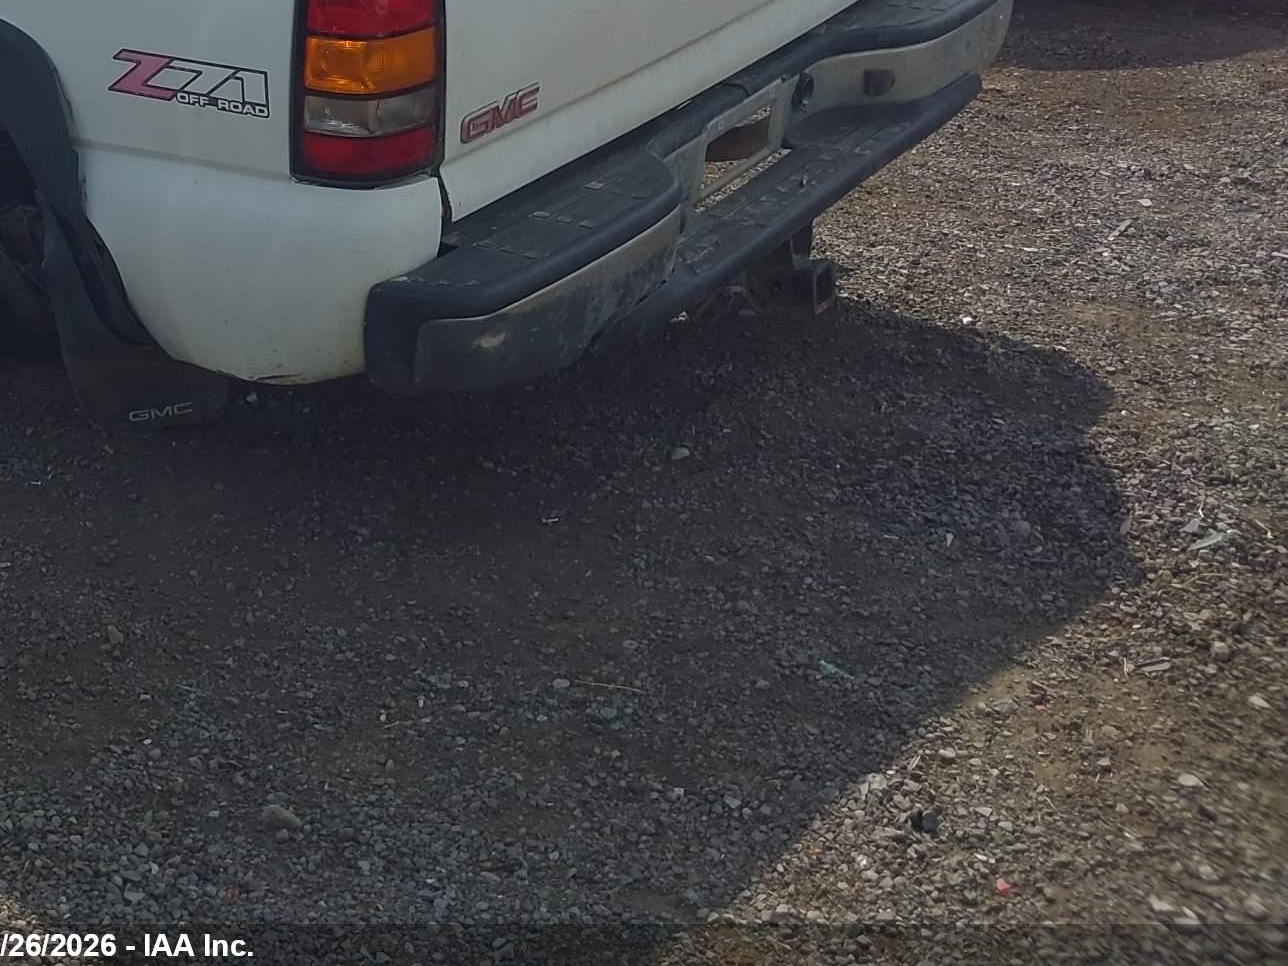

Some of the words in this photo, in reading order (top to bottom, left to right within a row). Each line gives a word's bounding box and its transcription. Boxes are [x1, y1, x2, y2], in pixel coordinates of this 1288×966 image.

[108, 48, 269, 102] Z71
[176, 92, 210, 107] OFF
[217, 98, 268, 117] ROAD
[460, 82, 540, 144] GMC
[129, 401, 193, 422] GMC
